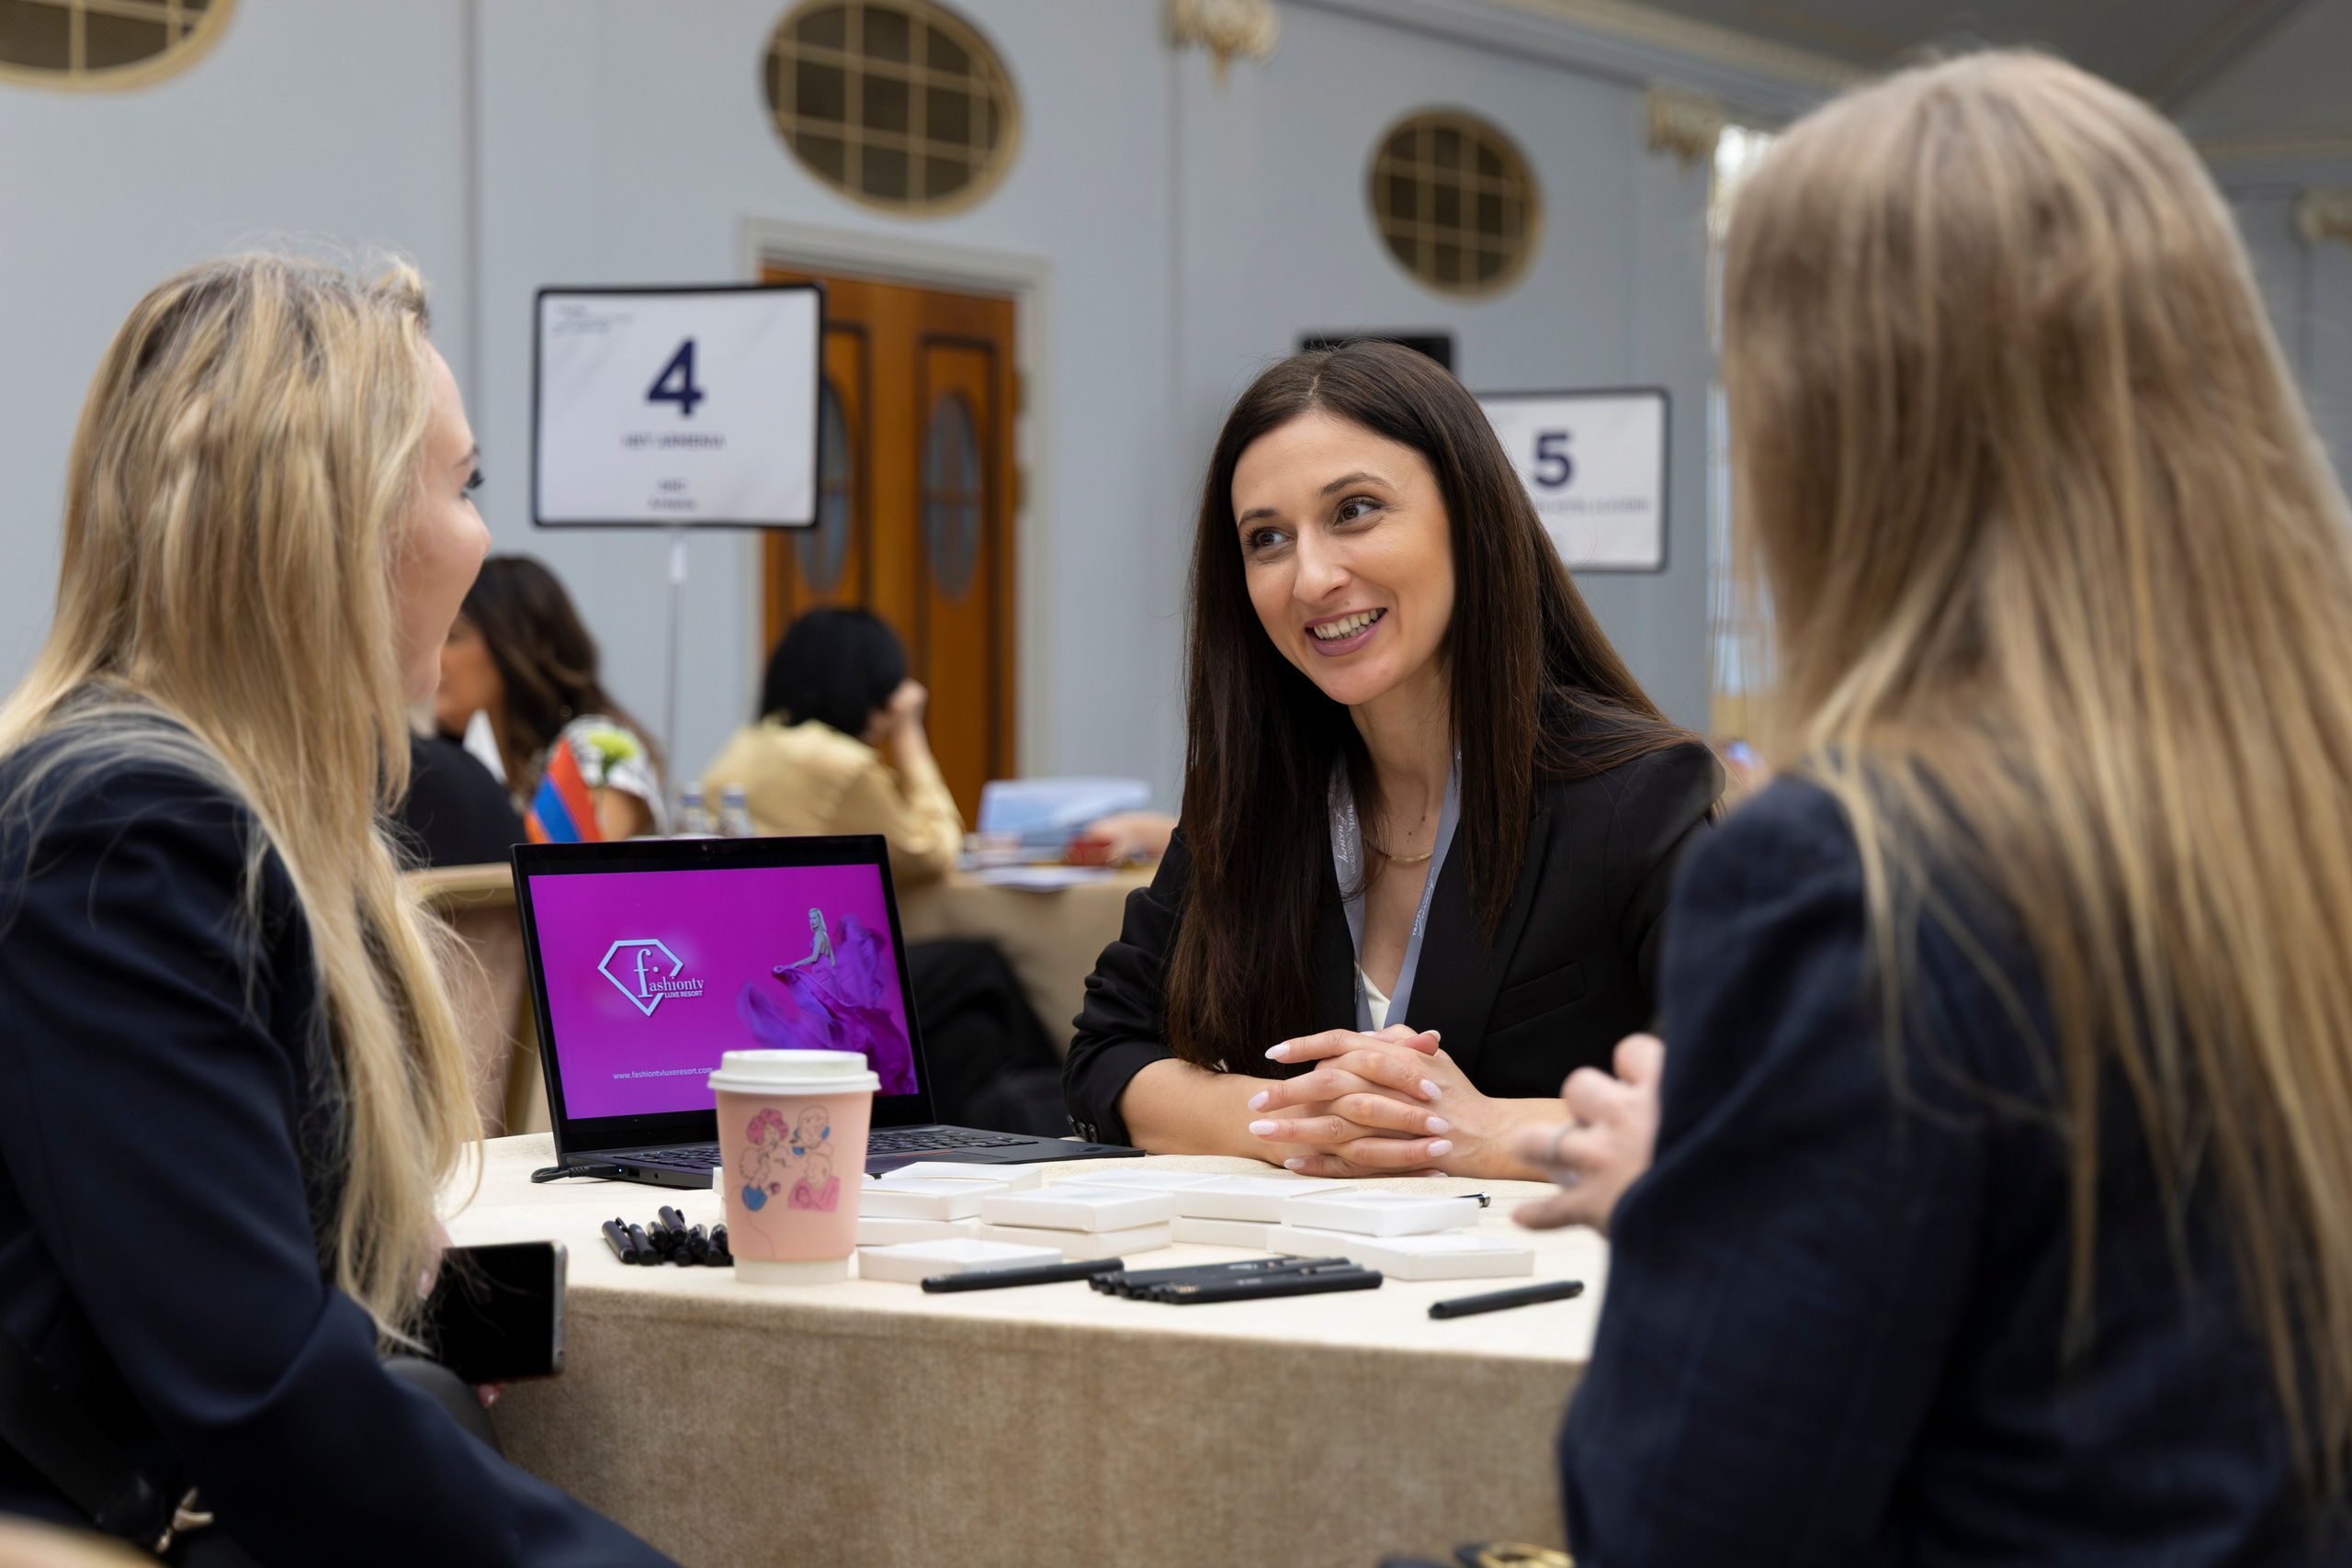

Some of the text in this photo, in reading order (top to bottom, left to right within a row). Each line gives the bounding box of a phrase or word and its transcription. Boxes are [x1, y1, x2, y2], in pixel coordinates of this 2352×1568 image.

[646, 338, 705, 416] 4
[1534, 432, 1573, 489] 5
[1347, 804, 1356, 829] TRAVEL
[613, 1067, 714, 1079] www.fashiontvluxeresort.com
